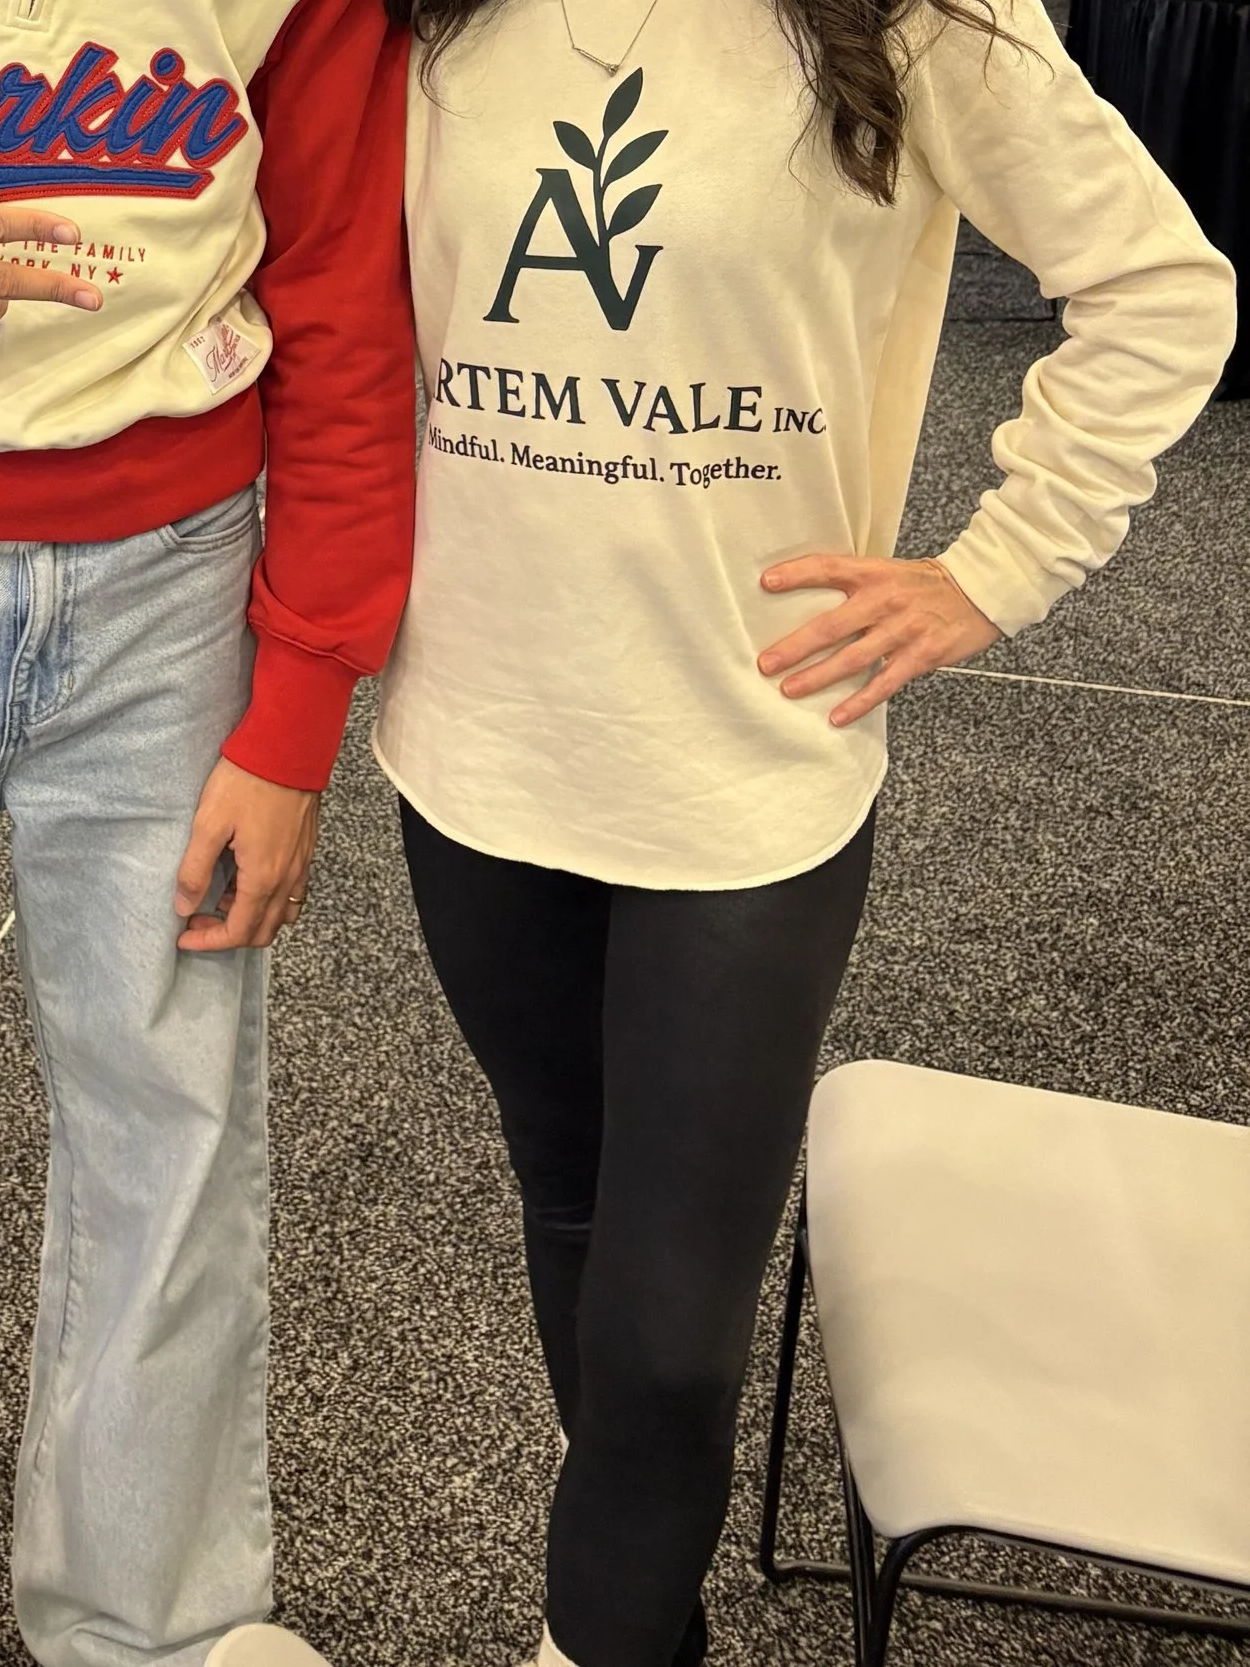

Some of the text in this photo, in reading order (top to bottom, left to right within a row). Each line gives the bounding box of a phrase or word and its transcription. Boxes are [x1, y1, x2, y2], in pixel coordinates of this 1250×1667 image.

[70, 263, 97, 280] NY
[74, 242, 146, 262] FAMILY
[435, 357, 586, 425] RTEM
[601, 378, 764, 434] VALE
[428, 422, 782, 489] Mindful. Meaningful. Together.
